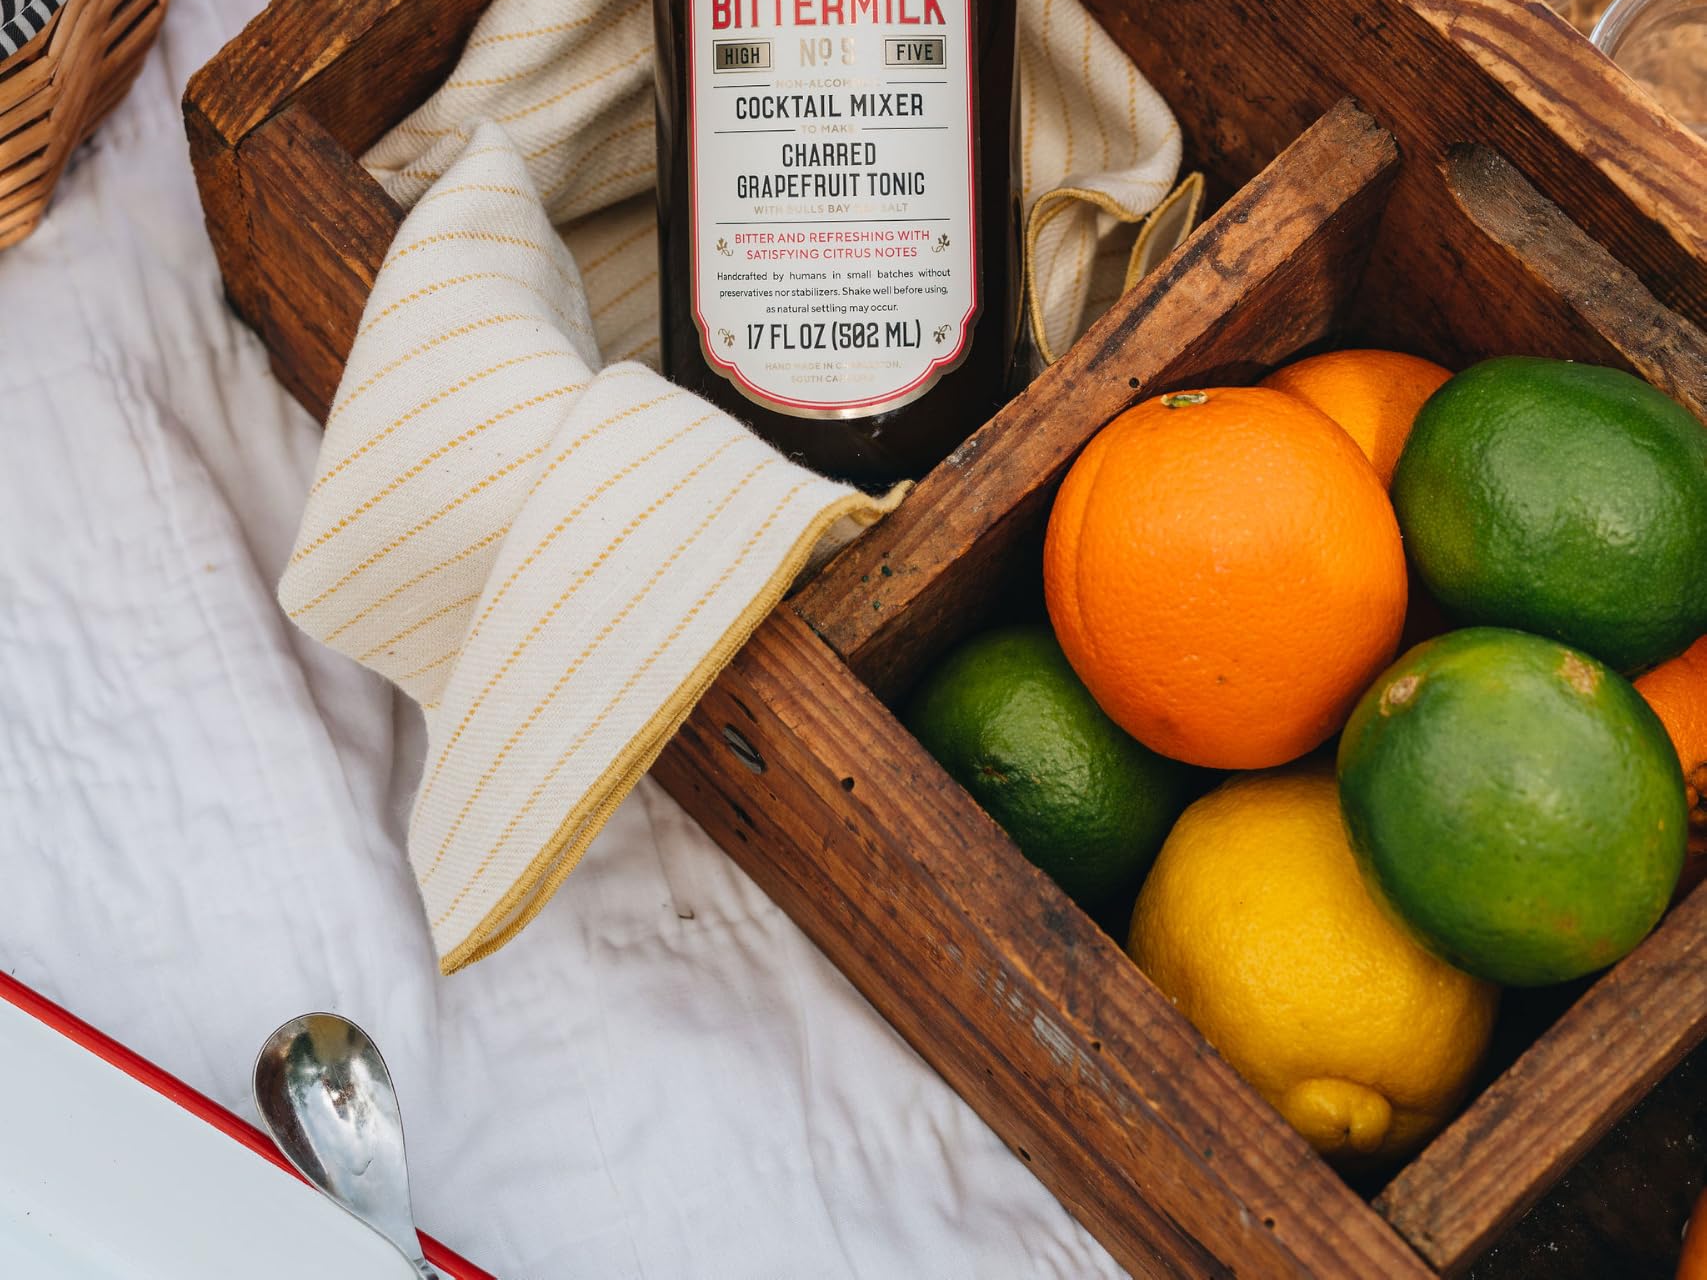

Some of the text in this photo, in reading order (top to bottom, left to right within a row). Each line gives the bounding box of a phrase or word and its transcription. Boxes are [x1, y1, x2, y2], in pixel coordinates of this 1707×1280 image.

[725, 48, 760, 64] HIGH
[897, 45, 933, 60] FIVE
[736, 94, 923, 119] COCKTAIL MIXER
[783, 143, 875, 167] CHARRED
[738, 172, 924, 198] GRAPEFRUIT TONIC
[828, 204, 850, 213] BAY
[735, 230, 930, 244] BITTER AND REFRESHING WITH
[746, 246, 918, 260] SATISFYING CITRUS NOTES
[717, 268, 951, 283] Handcrafted by humans in small batches without
[719, 288, 774, 299] preservatives
[774, 289, 791, 297] nor
[791, 287, 841, 297] stabilizers.
[841, 286, 872, 296] Shake
[872, 285, 892, 295] well
[893, 285, 924, 295] before
[765, 303, 899, 315] as natural settling may occur.
[748, 319, 921, 350] 17 FL OZ (502 ML)
